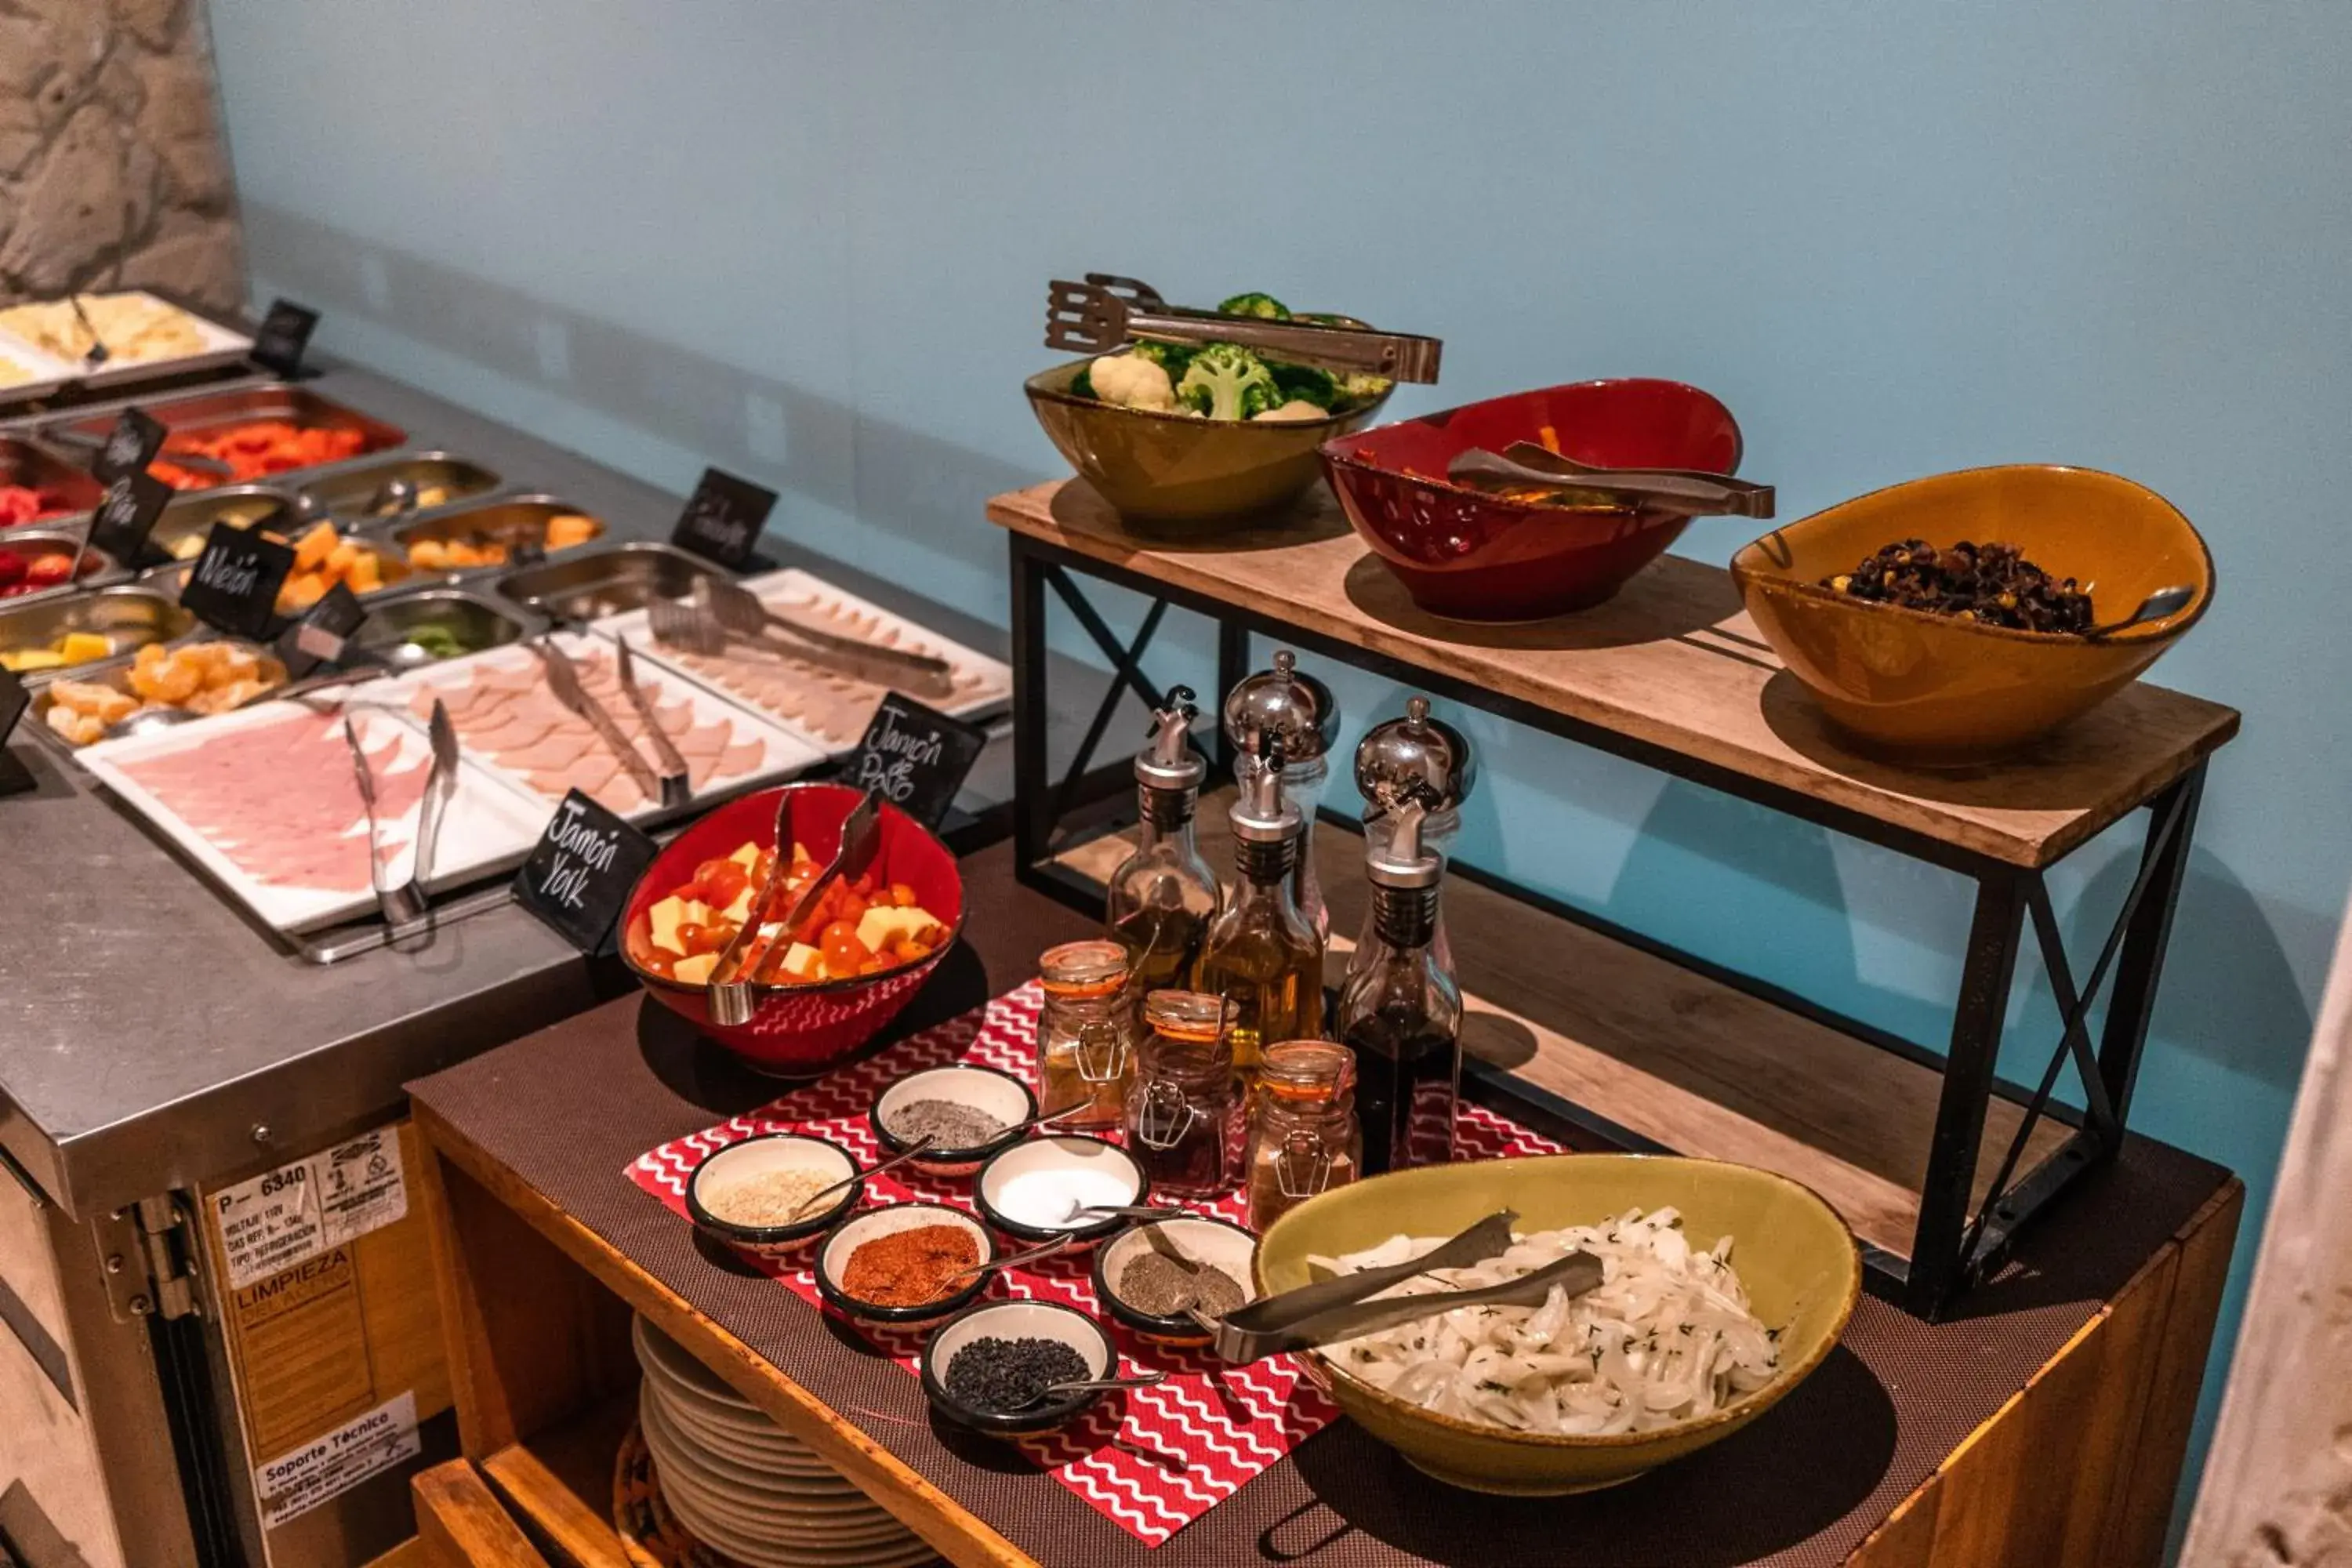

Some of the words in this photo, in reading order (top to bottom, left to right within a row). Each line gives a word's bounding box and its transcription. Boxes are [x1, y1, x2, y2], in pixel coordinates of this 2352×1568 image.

[866, 706, 942, 766] Jamón
[888, 758, 914, 778] de
[548, 799, 619, 873] Jamón
[539, 851, 590, 908] York
[261, 1166, 306, 1196] 6340
[238, 1250, 348, 1309] LIMPIEZA
[266, 1445, 327, 1483] Soporte
